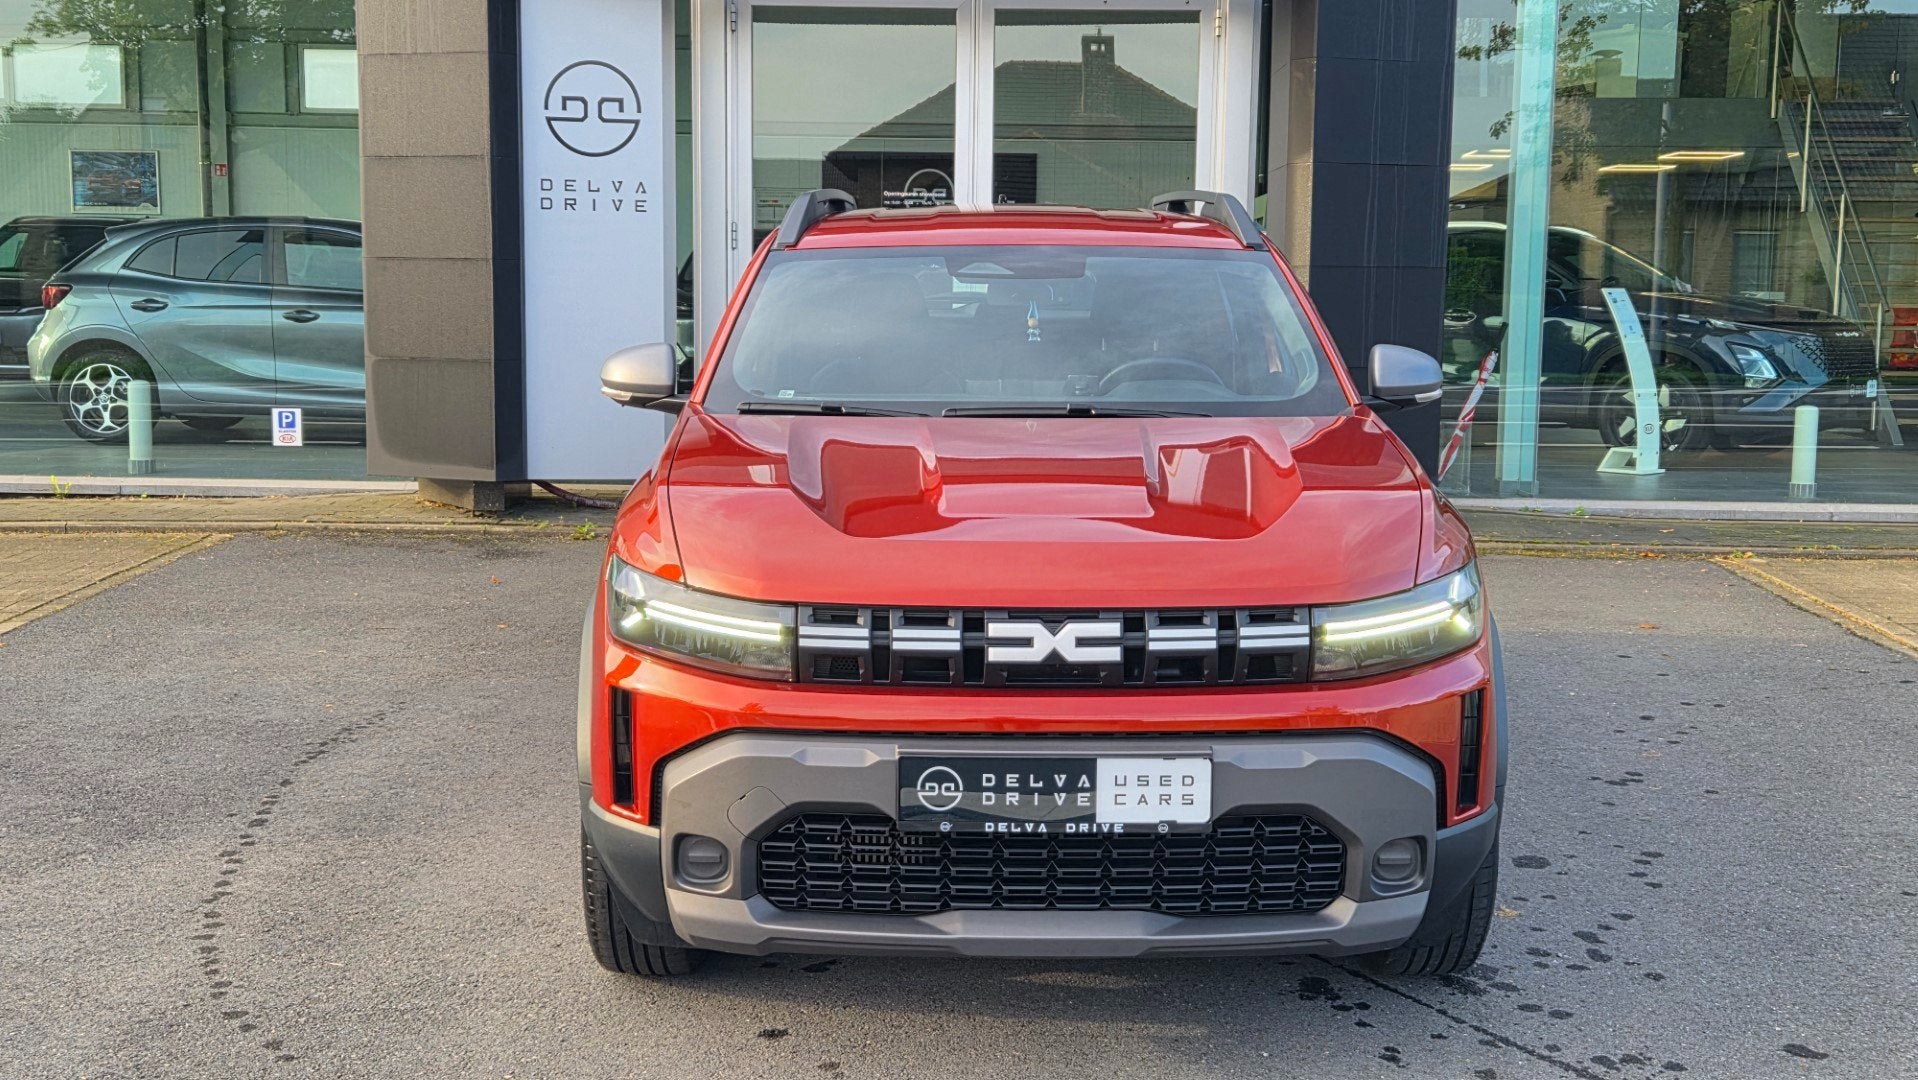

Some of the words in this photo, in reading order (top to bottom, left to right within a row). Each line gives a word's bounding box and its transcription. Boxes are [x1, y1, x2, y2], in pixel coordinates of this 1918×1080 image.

[540, 178, 647, 194] DELVA
[540, 197, 647, 212] DRIVE
[282, 412, 293, 428] P
[982, 773, 1090, 788] DELVA
[1114, 775, 1194, 787] USED
[982, 792, 1090, 806] DRIVE
[1114, 794, 1194, 806] CARS
[985, 822, 1047, 832] DELVA
[1066, 823, 1124, 833] DRIVE
